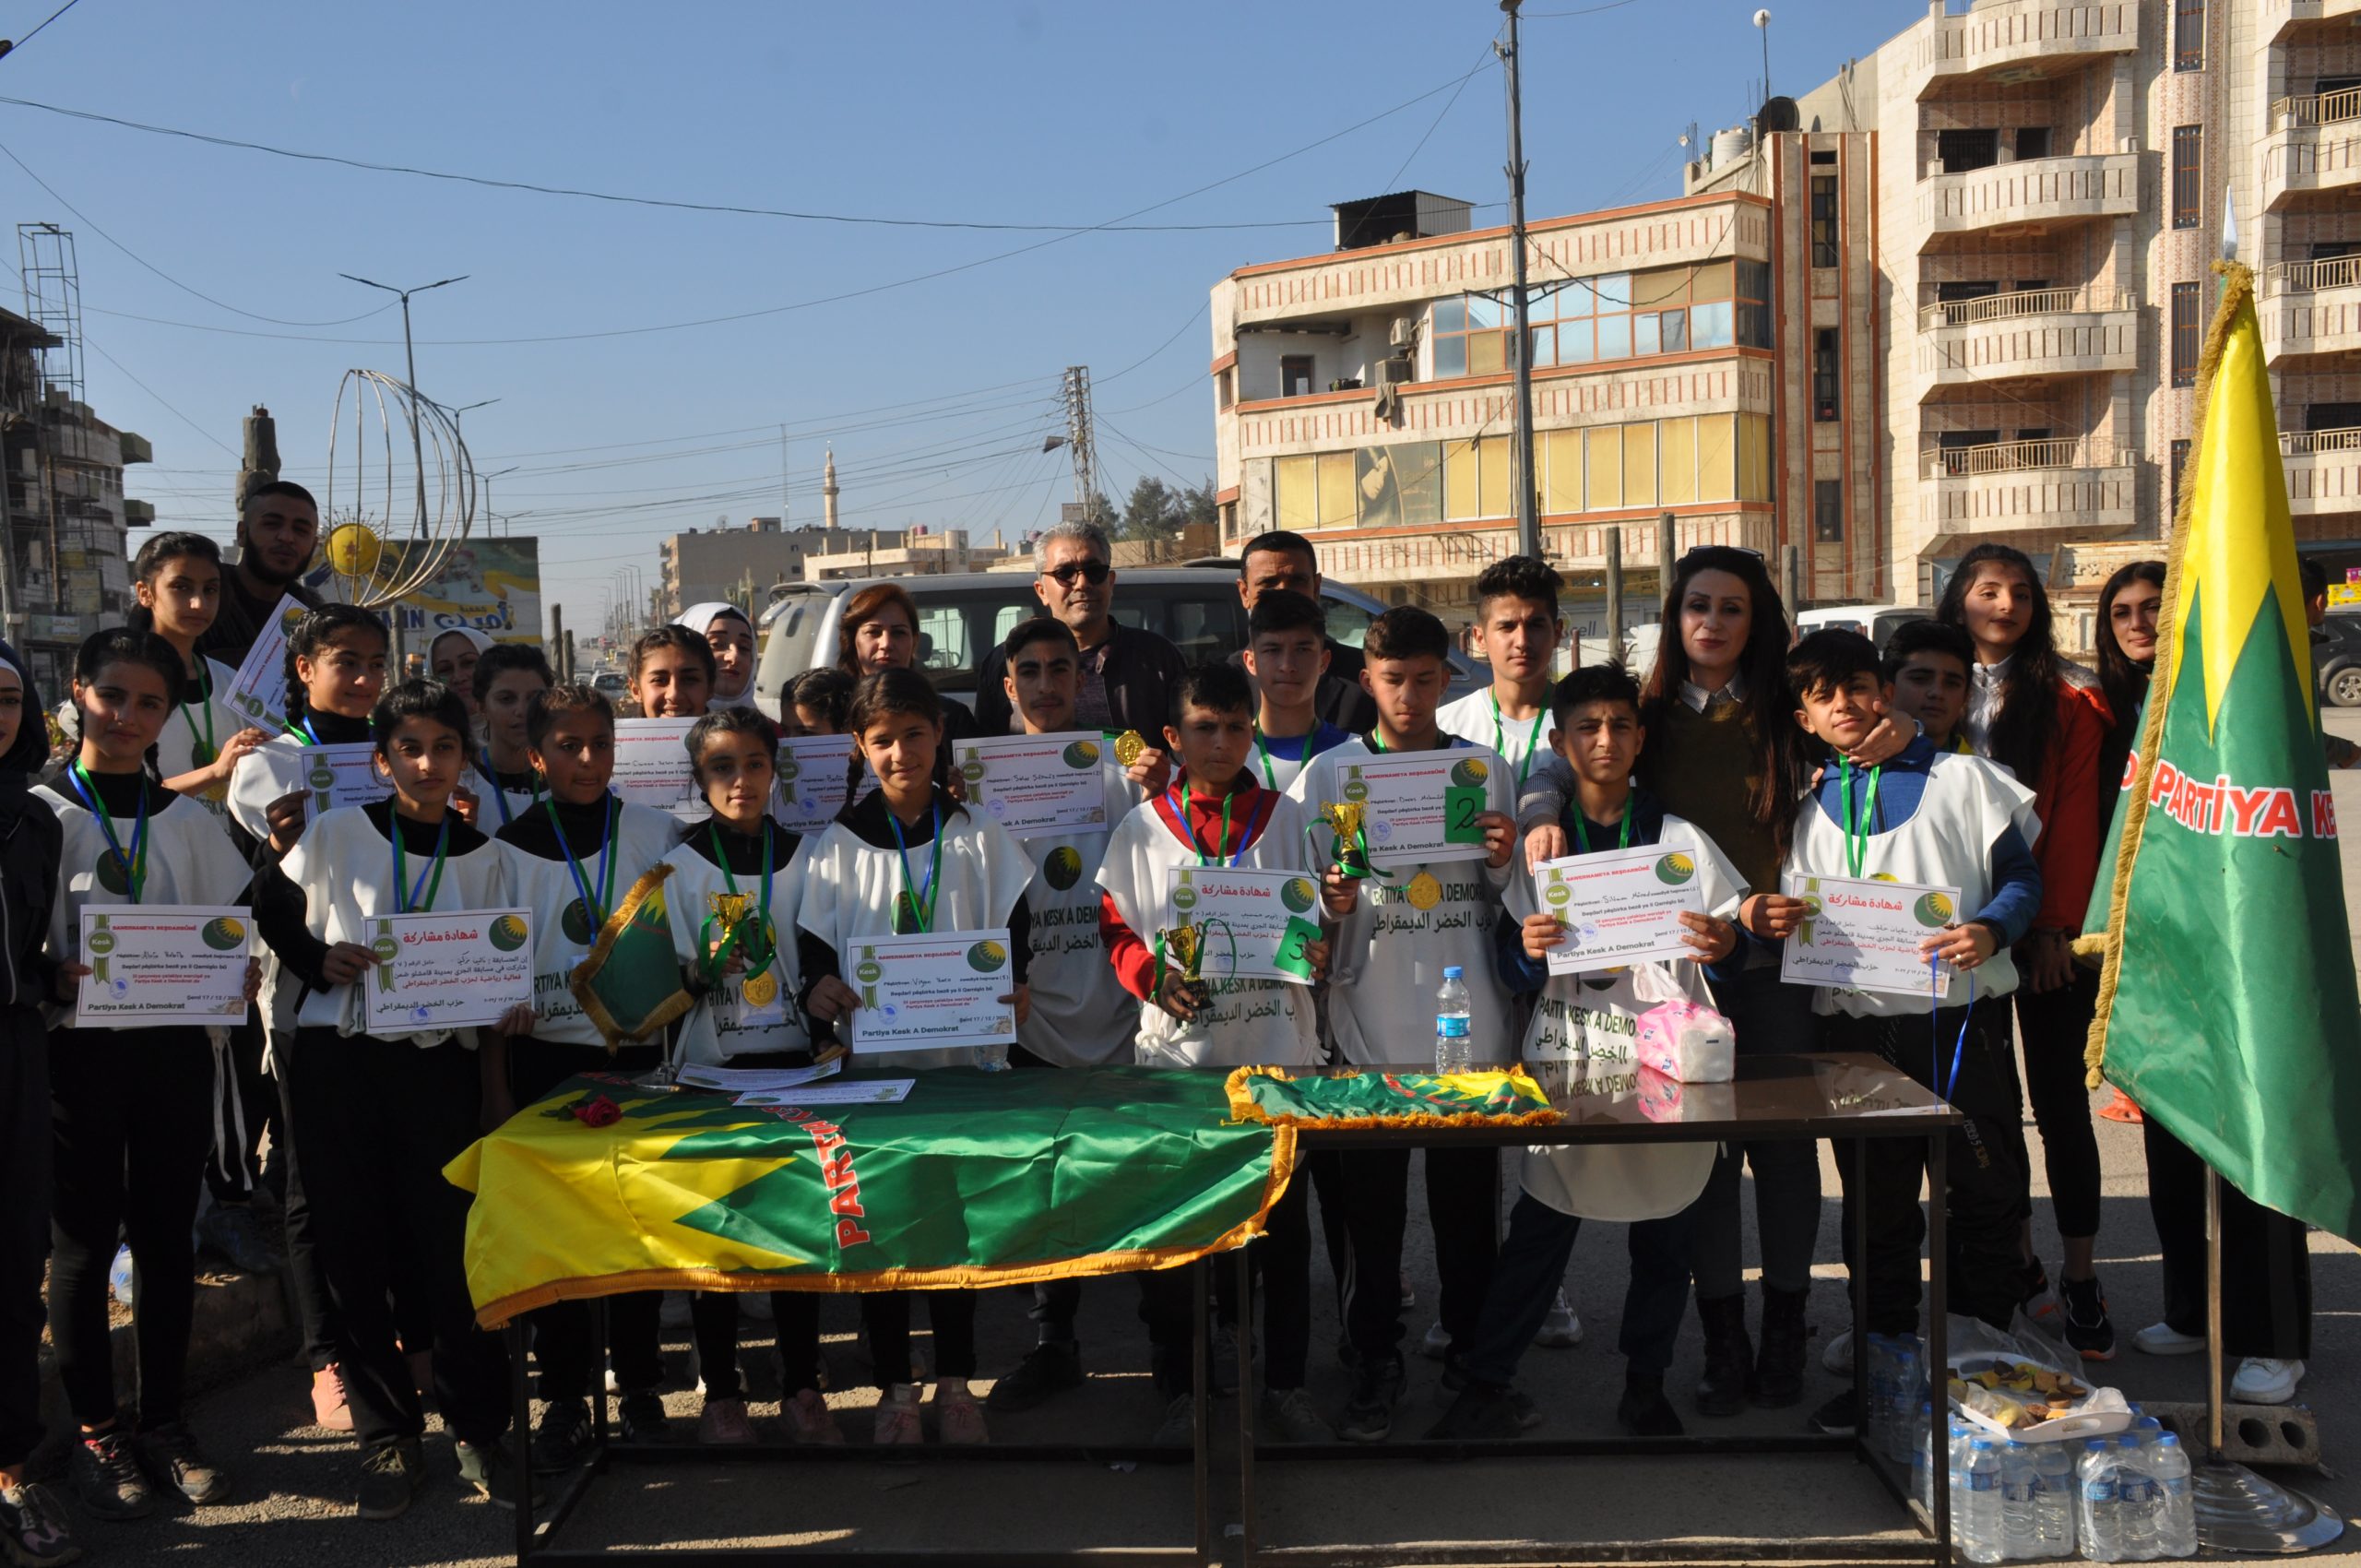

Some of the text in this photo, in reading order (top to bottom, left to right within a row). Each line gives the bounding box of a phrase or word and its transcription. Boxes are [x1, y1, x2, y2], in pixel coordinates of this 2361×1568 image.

[2151, 759, 2303, 837] PARTİYA
[1022, 816, 1056, 825] Demokrat
[1453, 797, 1477, 830] 2
[1343, 855, 1349, 863] 2
[1202, 885, 1271, 897] شهادة مشاركة
[1829, 894, 1903, 911] شهادة مشاركة
[1044, 907, 1064, 926] KESK
[1066, 907, 1074, 924] A
[1370, 911, 1471, 939] الخضر الديمقراطي
[403, 929, 478, 945] شهادة مشاركة
[1063, 932, 1098, 955] الخضر
[1288, 932, 1309, 960] 3
[1558, 950, 1585, 958] Partiya
[1587, 947, 1606, 956] Kesk
[1617, 941, 1655, 951] Demokrat
[1792, 956, 1833, 966] الديمقراطي
[376, 999, 465, 1013] حزب الخضر الديمقراطي
[1244, 999, 1280, 1022] الخضر
[1569, 1004, 1594, 1027] KESK
[1595, 1011, 1602, 1029] A
[862, 1029, 890, 1038] Partiya
[892, 1028, 911, 1036] Kesk
[921, 1026, 958, 1034] Demokrat
